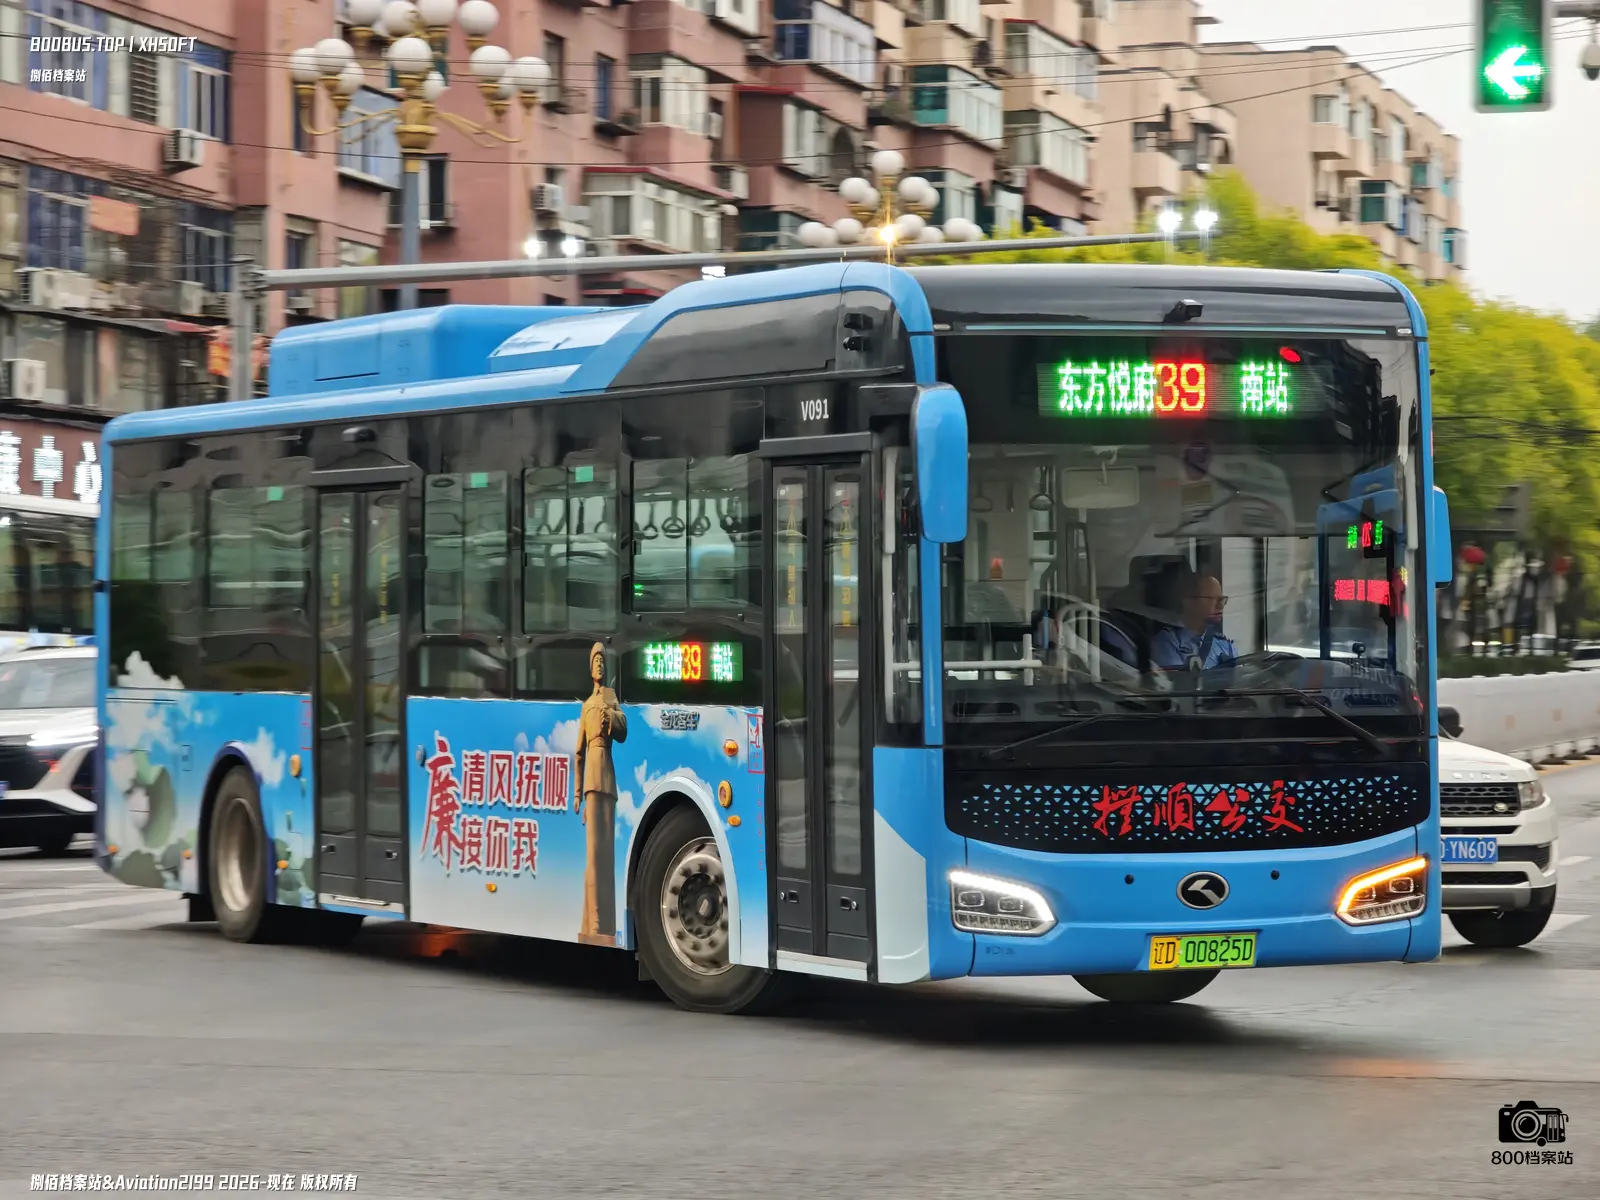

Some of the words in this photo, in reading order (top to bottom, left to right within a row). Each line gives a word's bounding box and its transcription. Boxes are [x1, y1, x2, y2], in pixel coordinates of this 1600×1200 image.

[800, 398, 830, 421] V091
[1058, 361, 1156, 413] 东方悦府
[1156, 363, 1206, 412] 39
[1242, 361, 1291, 413] 南站
[681, 644, 701, 680] 39
[462, 751, 570, 810] 清风抚顺
[460, 815, 539, 874] 接你我
